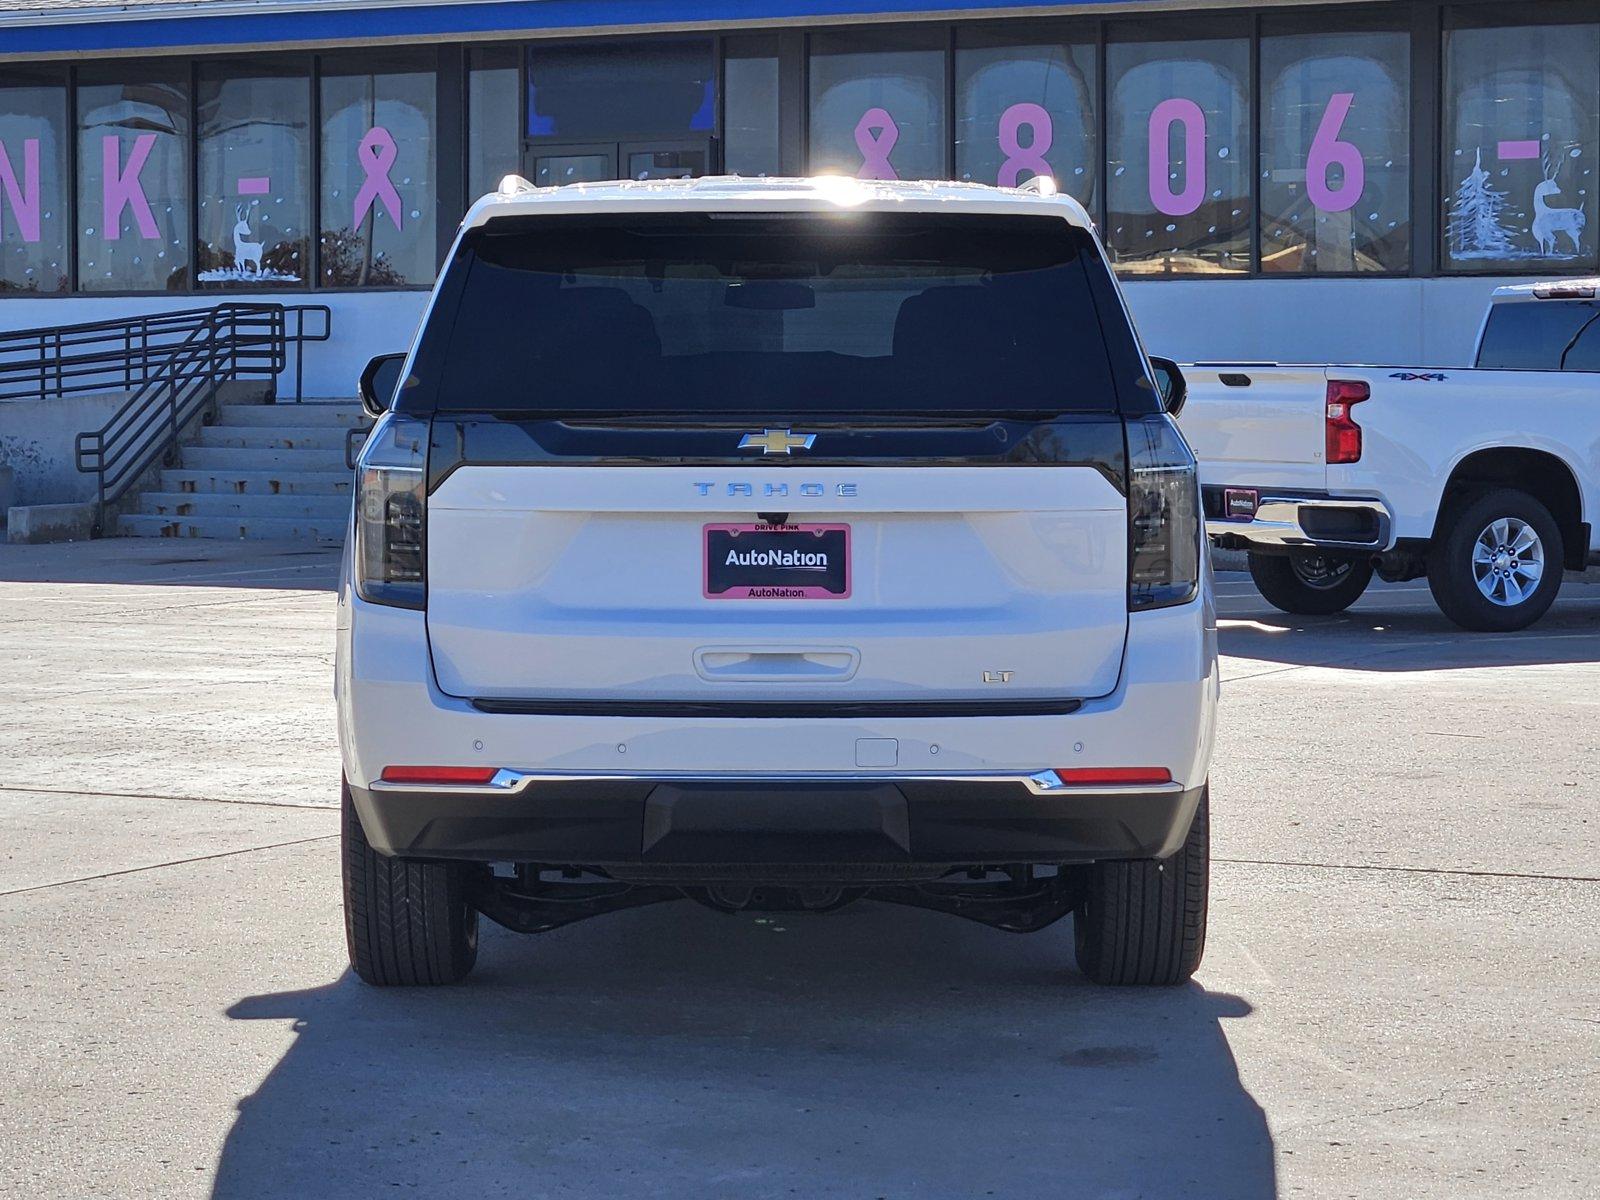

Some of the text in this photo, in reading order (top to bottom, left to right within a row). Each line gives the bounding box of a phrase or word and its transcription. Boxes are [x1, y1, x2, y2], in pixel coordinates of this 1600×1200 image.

[693, 482, 858, 497] TAHOE
[725, 550, 828, 567] AutoNation
[748, 587, 805, 599] AutoNation
[983, 671, 1014, 682] LT
